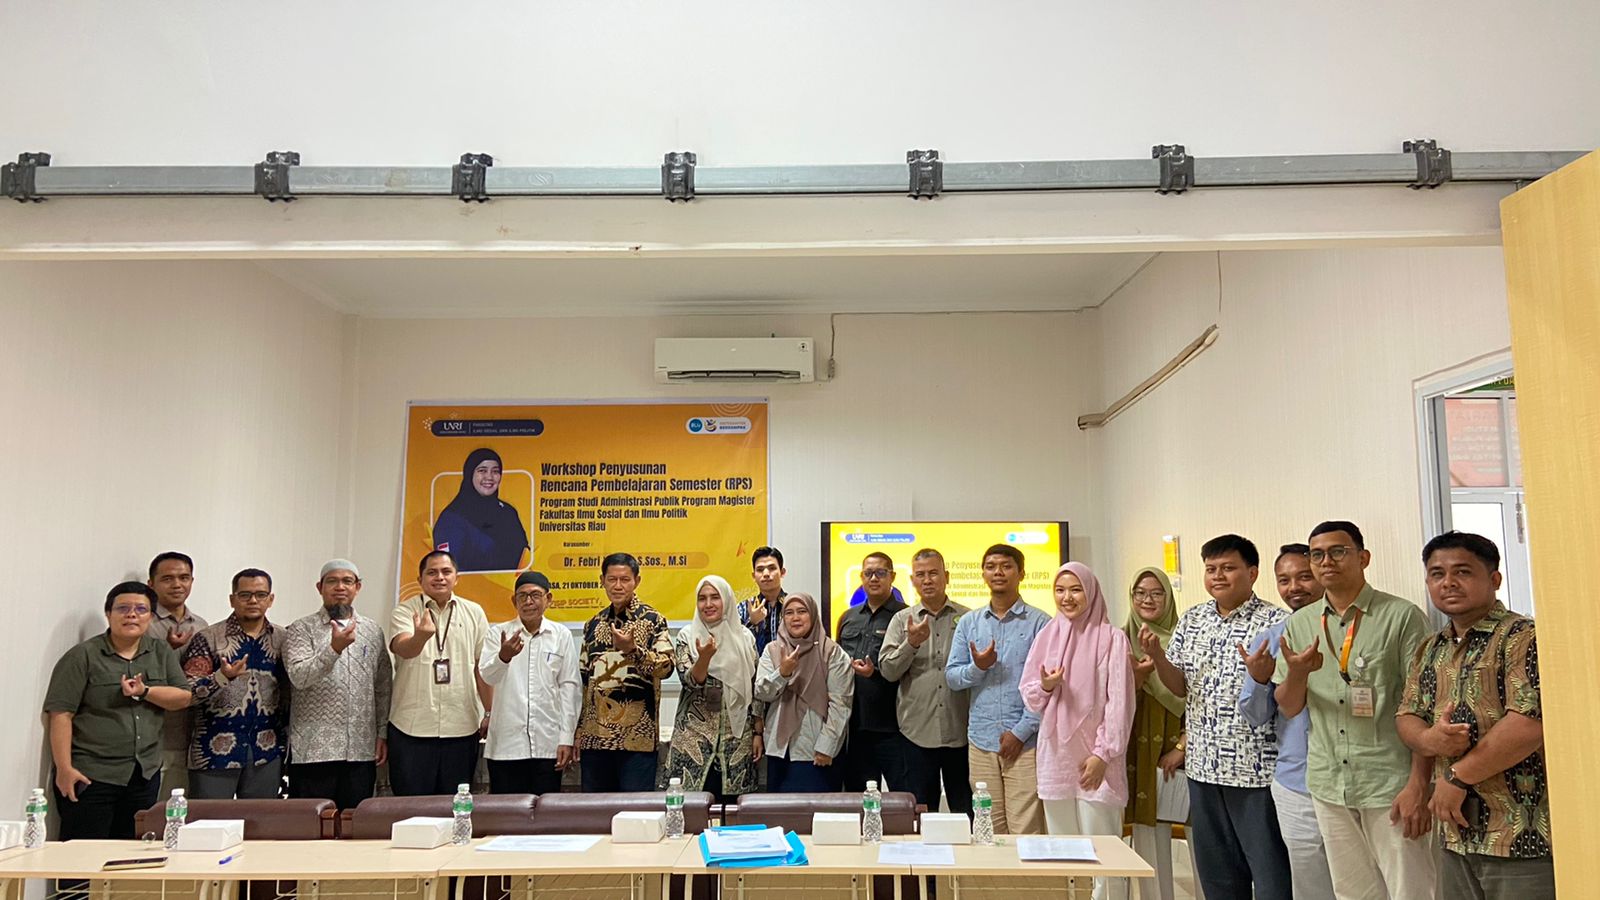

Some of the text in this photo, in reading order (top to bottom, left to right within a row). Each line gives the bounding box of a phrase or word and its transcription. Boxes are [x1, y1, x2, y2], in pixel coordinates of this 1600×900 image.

[541, 462, 666, 476] Workshop Penyusunan
[540, 477, 752, 492] Rencana Pembelajaran Semester (RPS)
[540, 496, 755, 508] Program Studi Administrasi Publik Program Magister
[540, 508, 688, 520] Fakultas Ilmu Sosial dan Ilmu Politik
[540, 521, 606, 532] Universitas Riau
[564, 555, 686, 567] Dr. Febri S.Sos., M.Si
